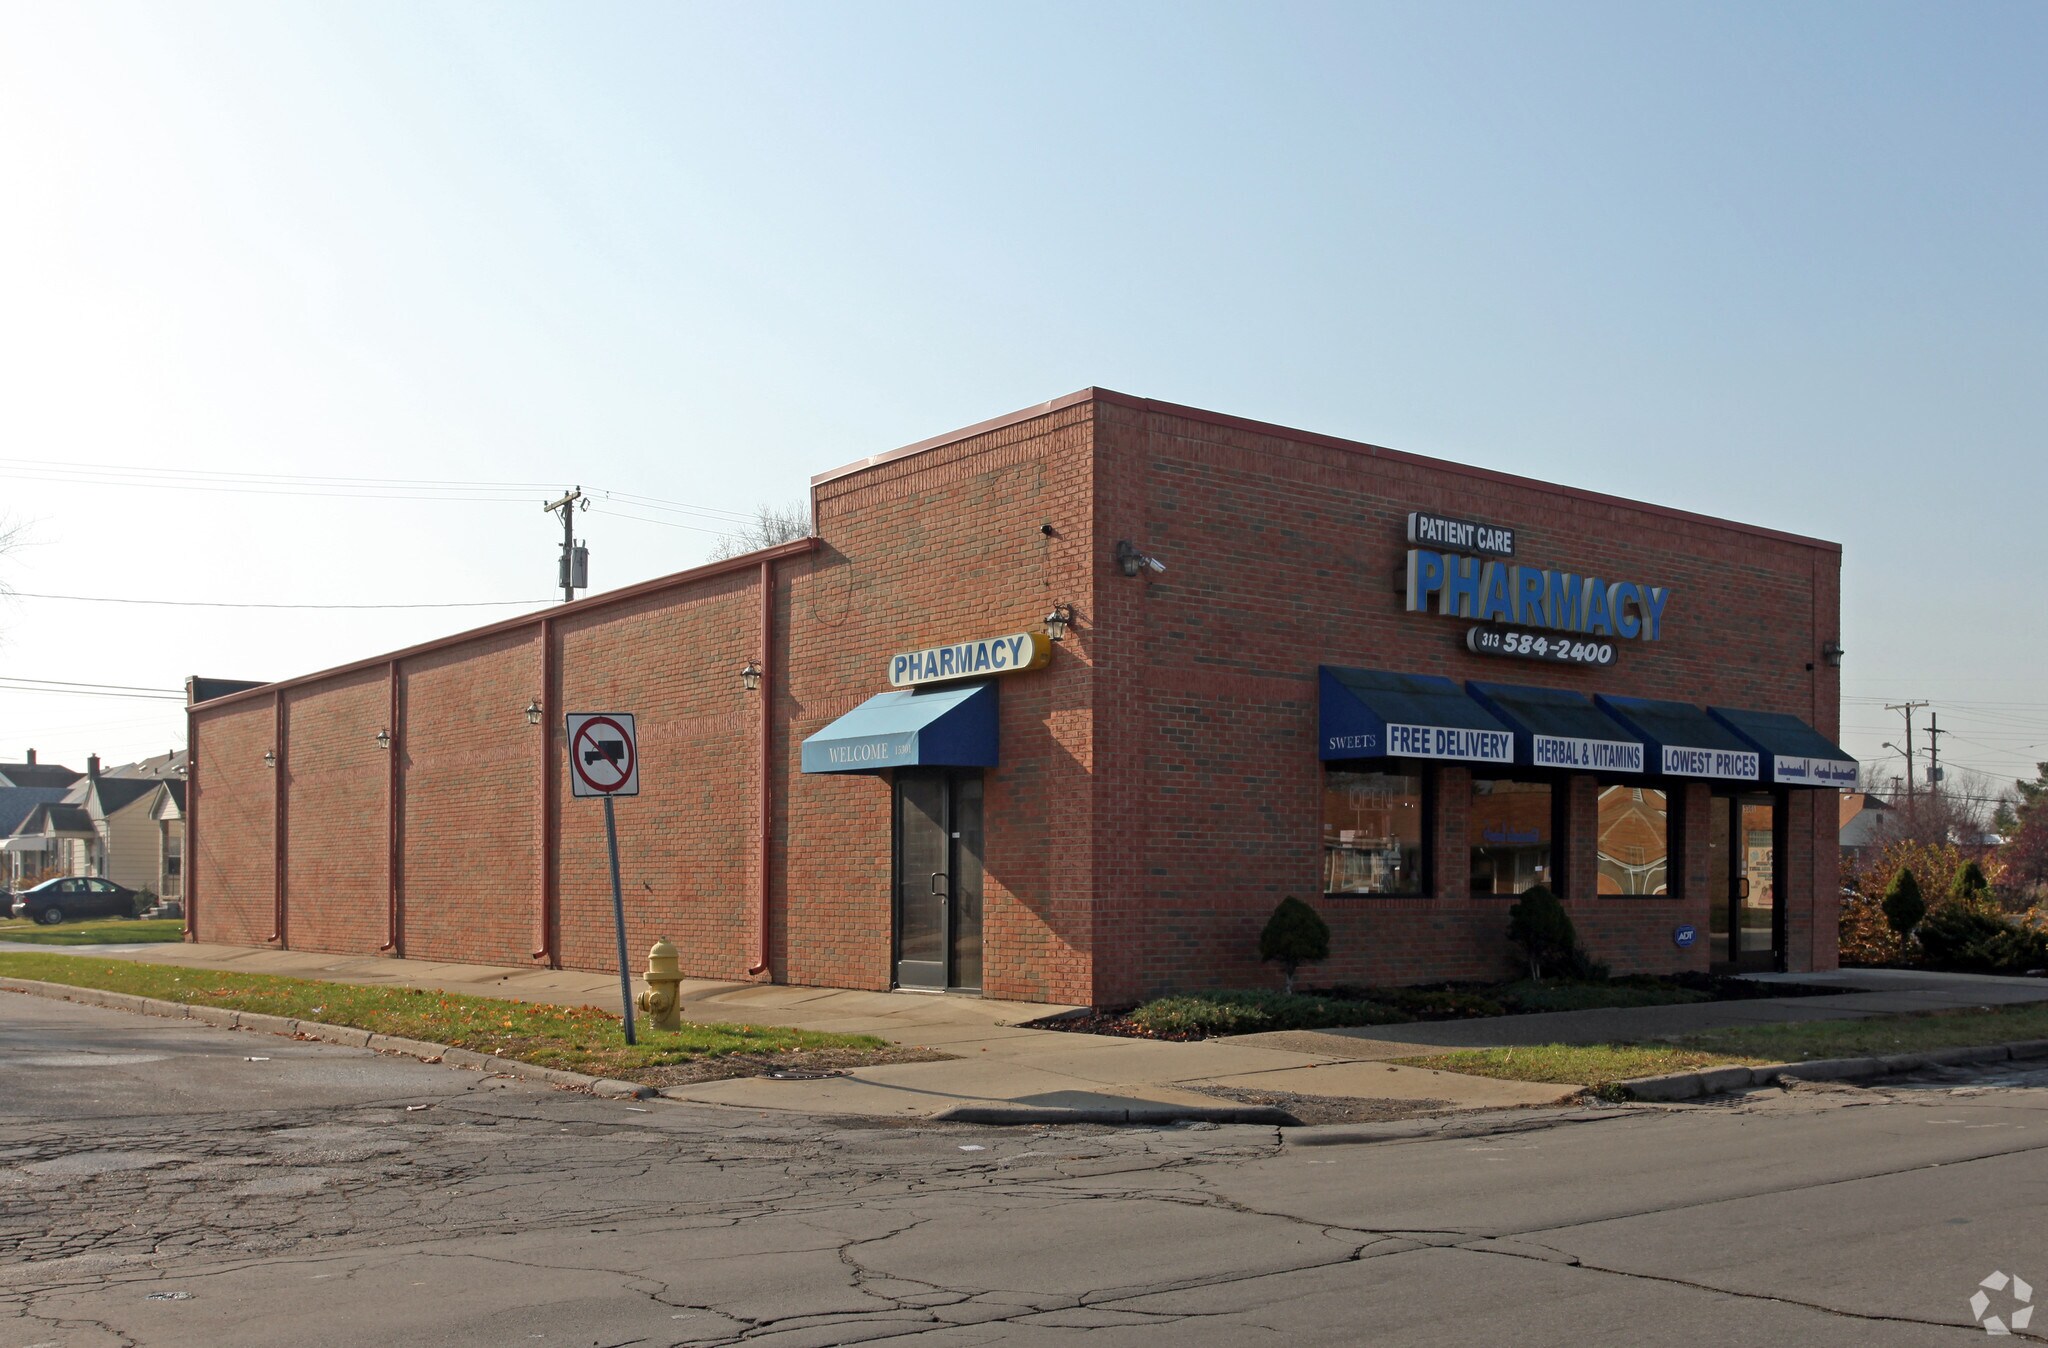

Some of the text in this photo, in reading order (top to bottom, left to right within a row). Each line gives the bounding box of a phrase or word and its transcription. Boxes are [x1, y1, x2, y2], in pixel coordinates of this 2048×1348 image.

[1420, 516, 1512, 553] PATIENT CARE
[1407, 550, 1671, 641] PHARMACY
[894, 636, 1024, 683] PHARMACY
[1482, 632, 1612, 664] 313 584-2400
[829, 742, 889, 764] WELCOME
[1329, 734, 1377, 750] SWEETS
[1390, 726, 1510, 759] FREE DELIVERY
[1537, 738, 1641, 769] HERBAL & VITAMINS
[1664, 749, 1756, 777] LOWEST PRICES
[1351, 789, 1391, 809] OPEN
[1677, 930, 1694, 941] ADT
